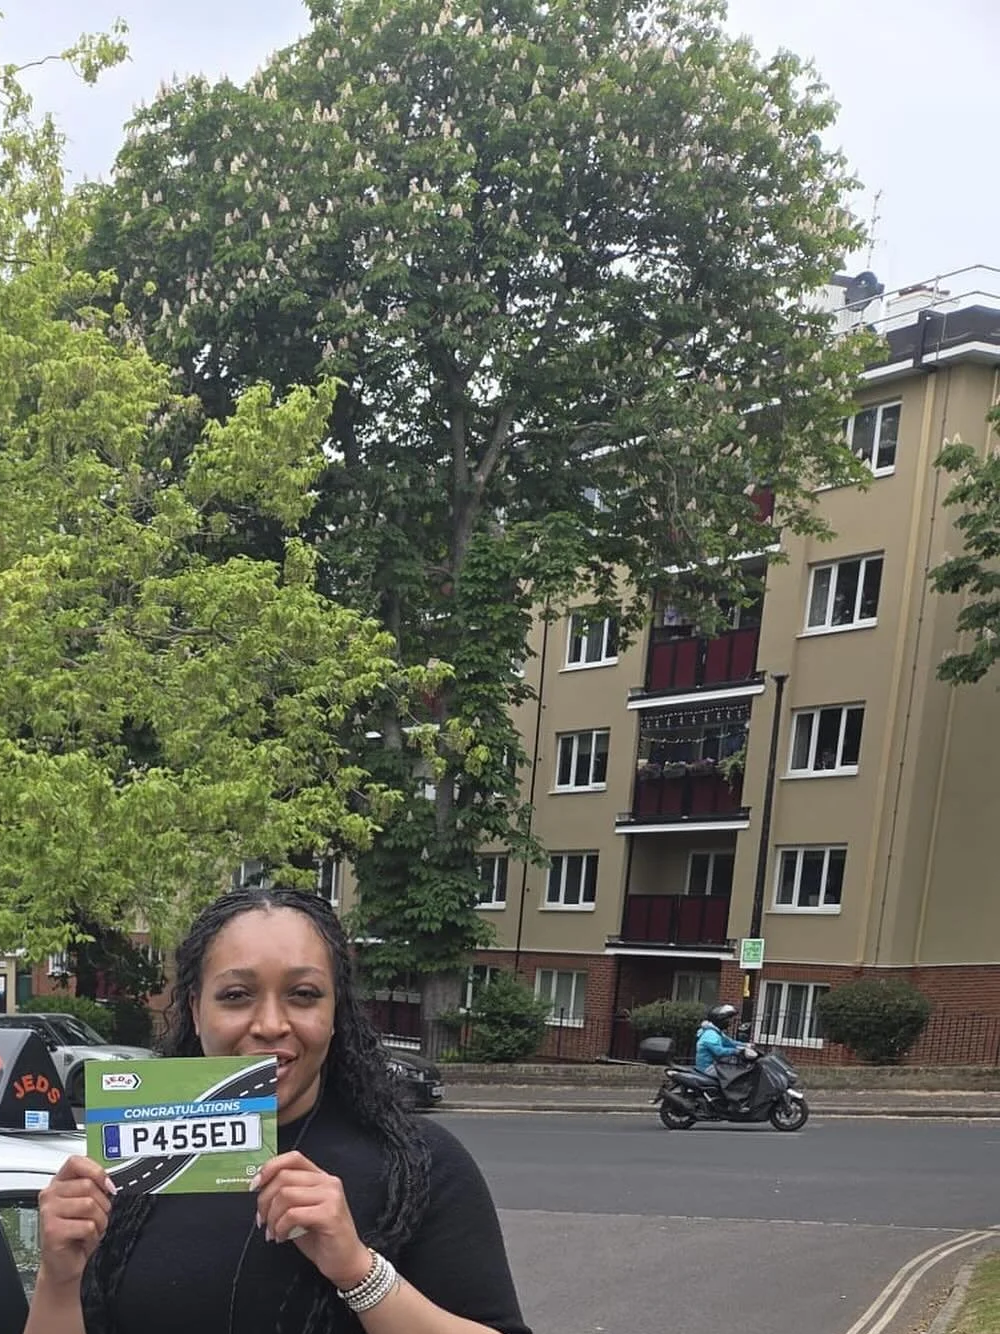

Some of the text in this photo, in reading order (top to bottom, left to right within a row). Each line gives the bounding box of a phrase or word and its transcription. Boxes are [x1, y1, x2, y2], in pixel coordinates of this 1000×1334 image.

[13, 1074, 61, 1104] JEDS
[124, 1101, 240, 1119] CONGRATULATIONS
[133, 1121, 246, 1153] P455ED
